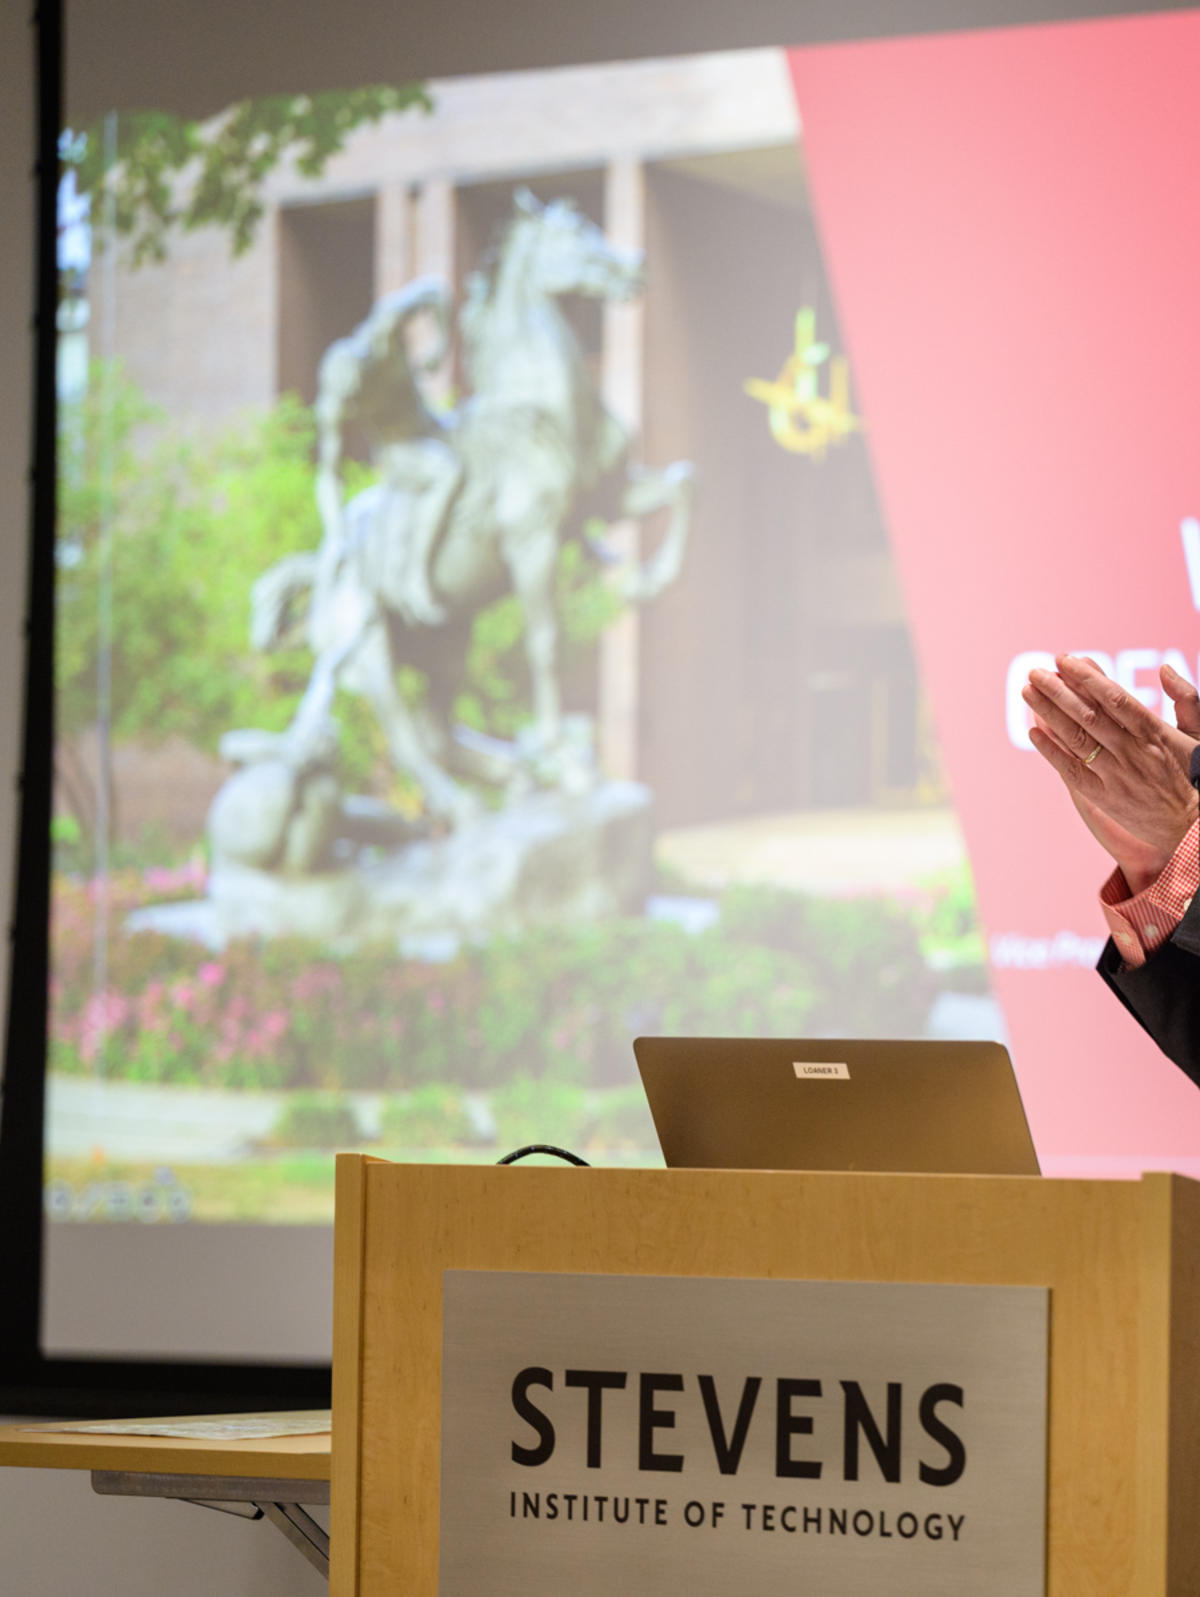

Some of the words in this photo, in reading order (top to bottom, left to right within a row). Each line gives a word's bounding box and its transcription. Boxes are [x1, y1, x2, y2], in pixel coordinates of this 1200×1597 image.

[510, 1366, 967, 1487] STEVENS
[510, 1491, 668, 1526] INSTITUTE
[683, 1500, 725, 1528] OF
[741, 1503, 966, 1541] TECHNOLOGY
